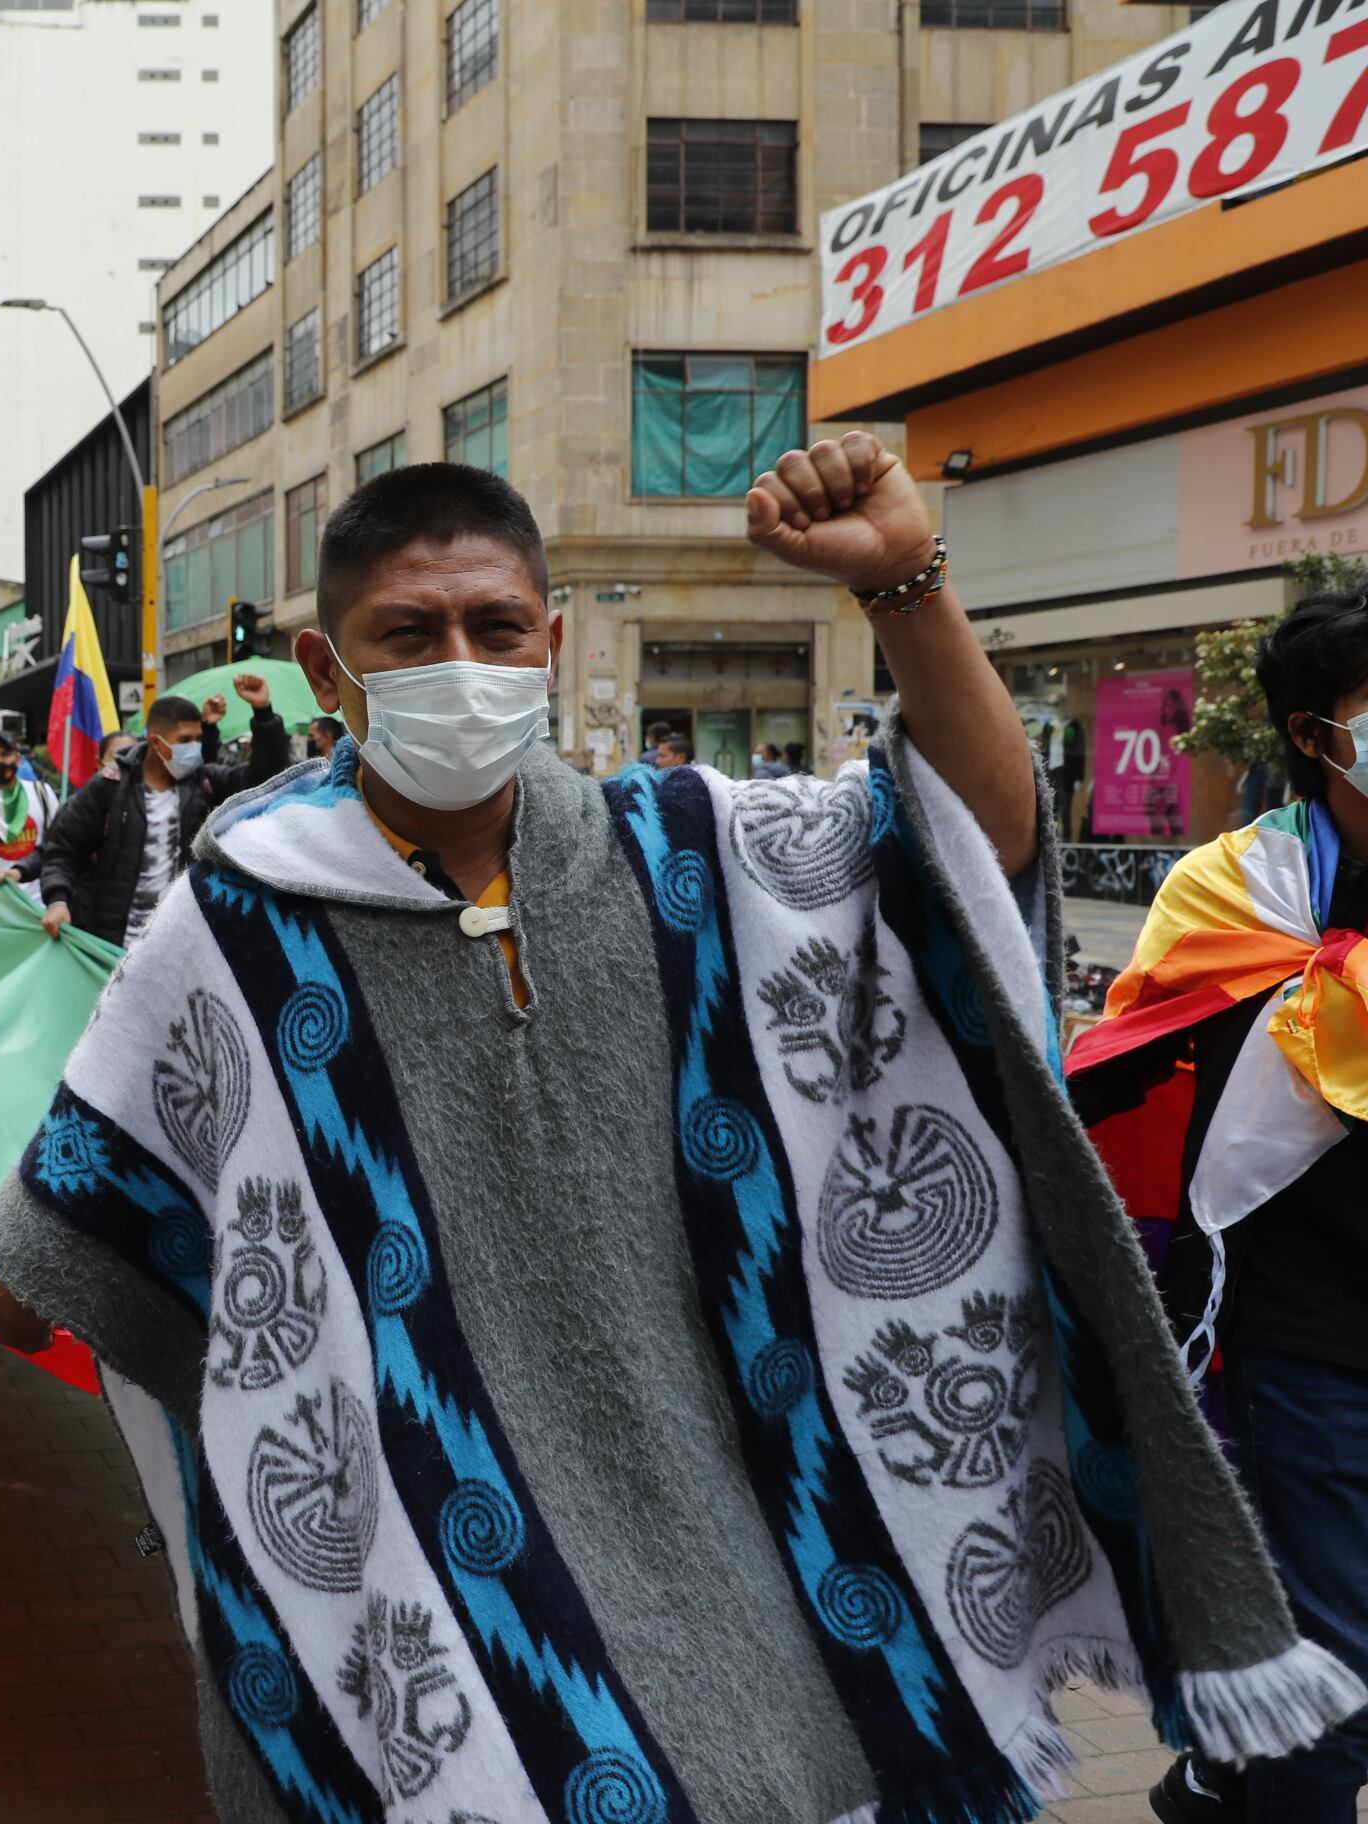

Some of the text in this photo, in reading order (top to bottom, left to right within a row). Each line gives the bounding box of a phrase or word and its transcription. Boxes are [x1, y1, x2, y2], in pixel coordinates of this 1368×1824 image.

[826, 17, 1368, 345] 312 587
[831, 42, 1192, 252] OFICINAS
[1248, 527, 1359, 560] FUERA DE
